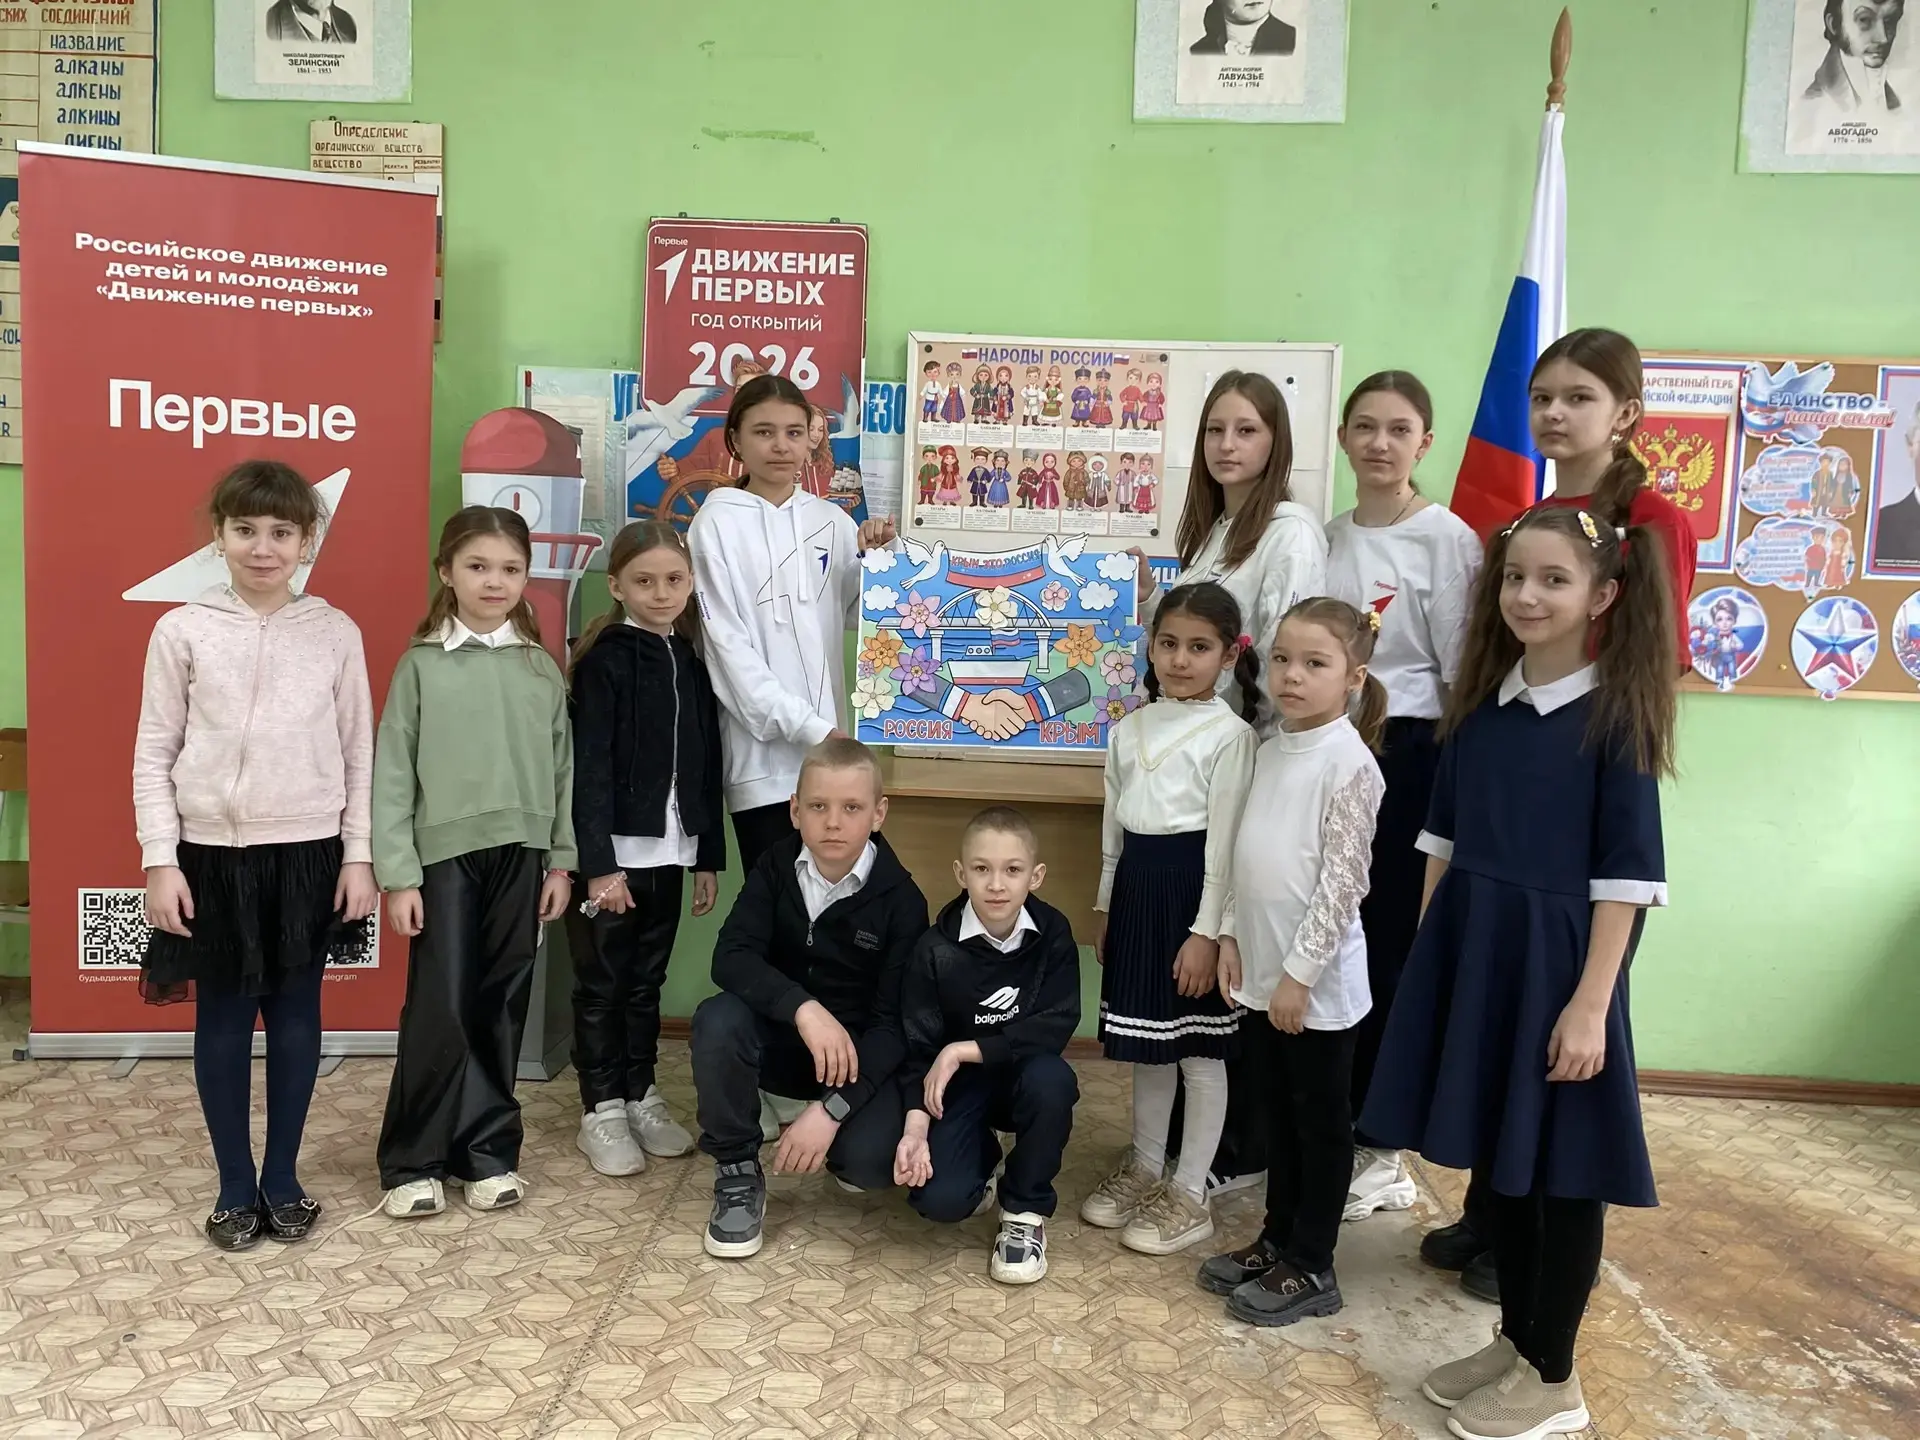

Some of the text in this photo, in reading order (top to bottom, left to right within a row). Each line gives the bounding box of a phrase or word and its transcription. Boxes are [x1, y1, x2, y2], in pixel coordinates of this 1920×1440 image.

[41, 7, 131, 25] СОЕДИНЕНИЙ
[288, 58, 340, 67] ЗЕЛИНСКИЙ
[1217, 73, 1265, 81] ЛАВУАЗЬЕ
[1828, 128, 1879, 137] АБОГАДРО
[315, 142, 423, 154] ОРГАНИЧЕСКИХ ВЕЩЕСТВ
[312, 159, 363, 170] ВЕЩЕСТВО
[653, 236, 689, 247] Первые
[76, 233, 389, 277] Российское движение
[691, 248, 855, 276] ДВИЖЕНИЕ
[105, 261, 359, 297] детей и молодёжи
[95, 281, 374, 319] «Движение первых»
[691, 276, 825, 306] ПЕРВЫХ
[691, 313, 823, 332] ГОД ОТКРЫТИЙ
[688, 341, 820, 391] 2026
[978, 347, 1113, 366] НАРОДЫ РОССИИ
[1711, 379, 1733, 389] ГЕРБ
[1677, 393, 1733, 405] ФЕДЕРАЦИИ
[1769, 394, 1873, 409] ЕДИНСТВО
[109, 378, 356, 449] Первые
[883, 719, 953, 744] РОССИЯ
[1039, 722, 1101, 746] КРЫМ
